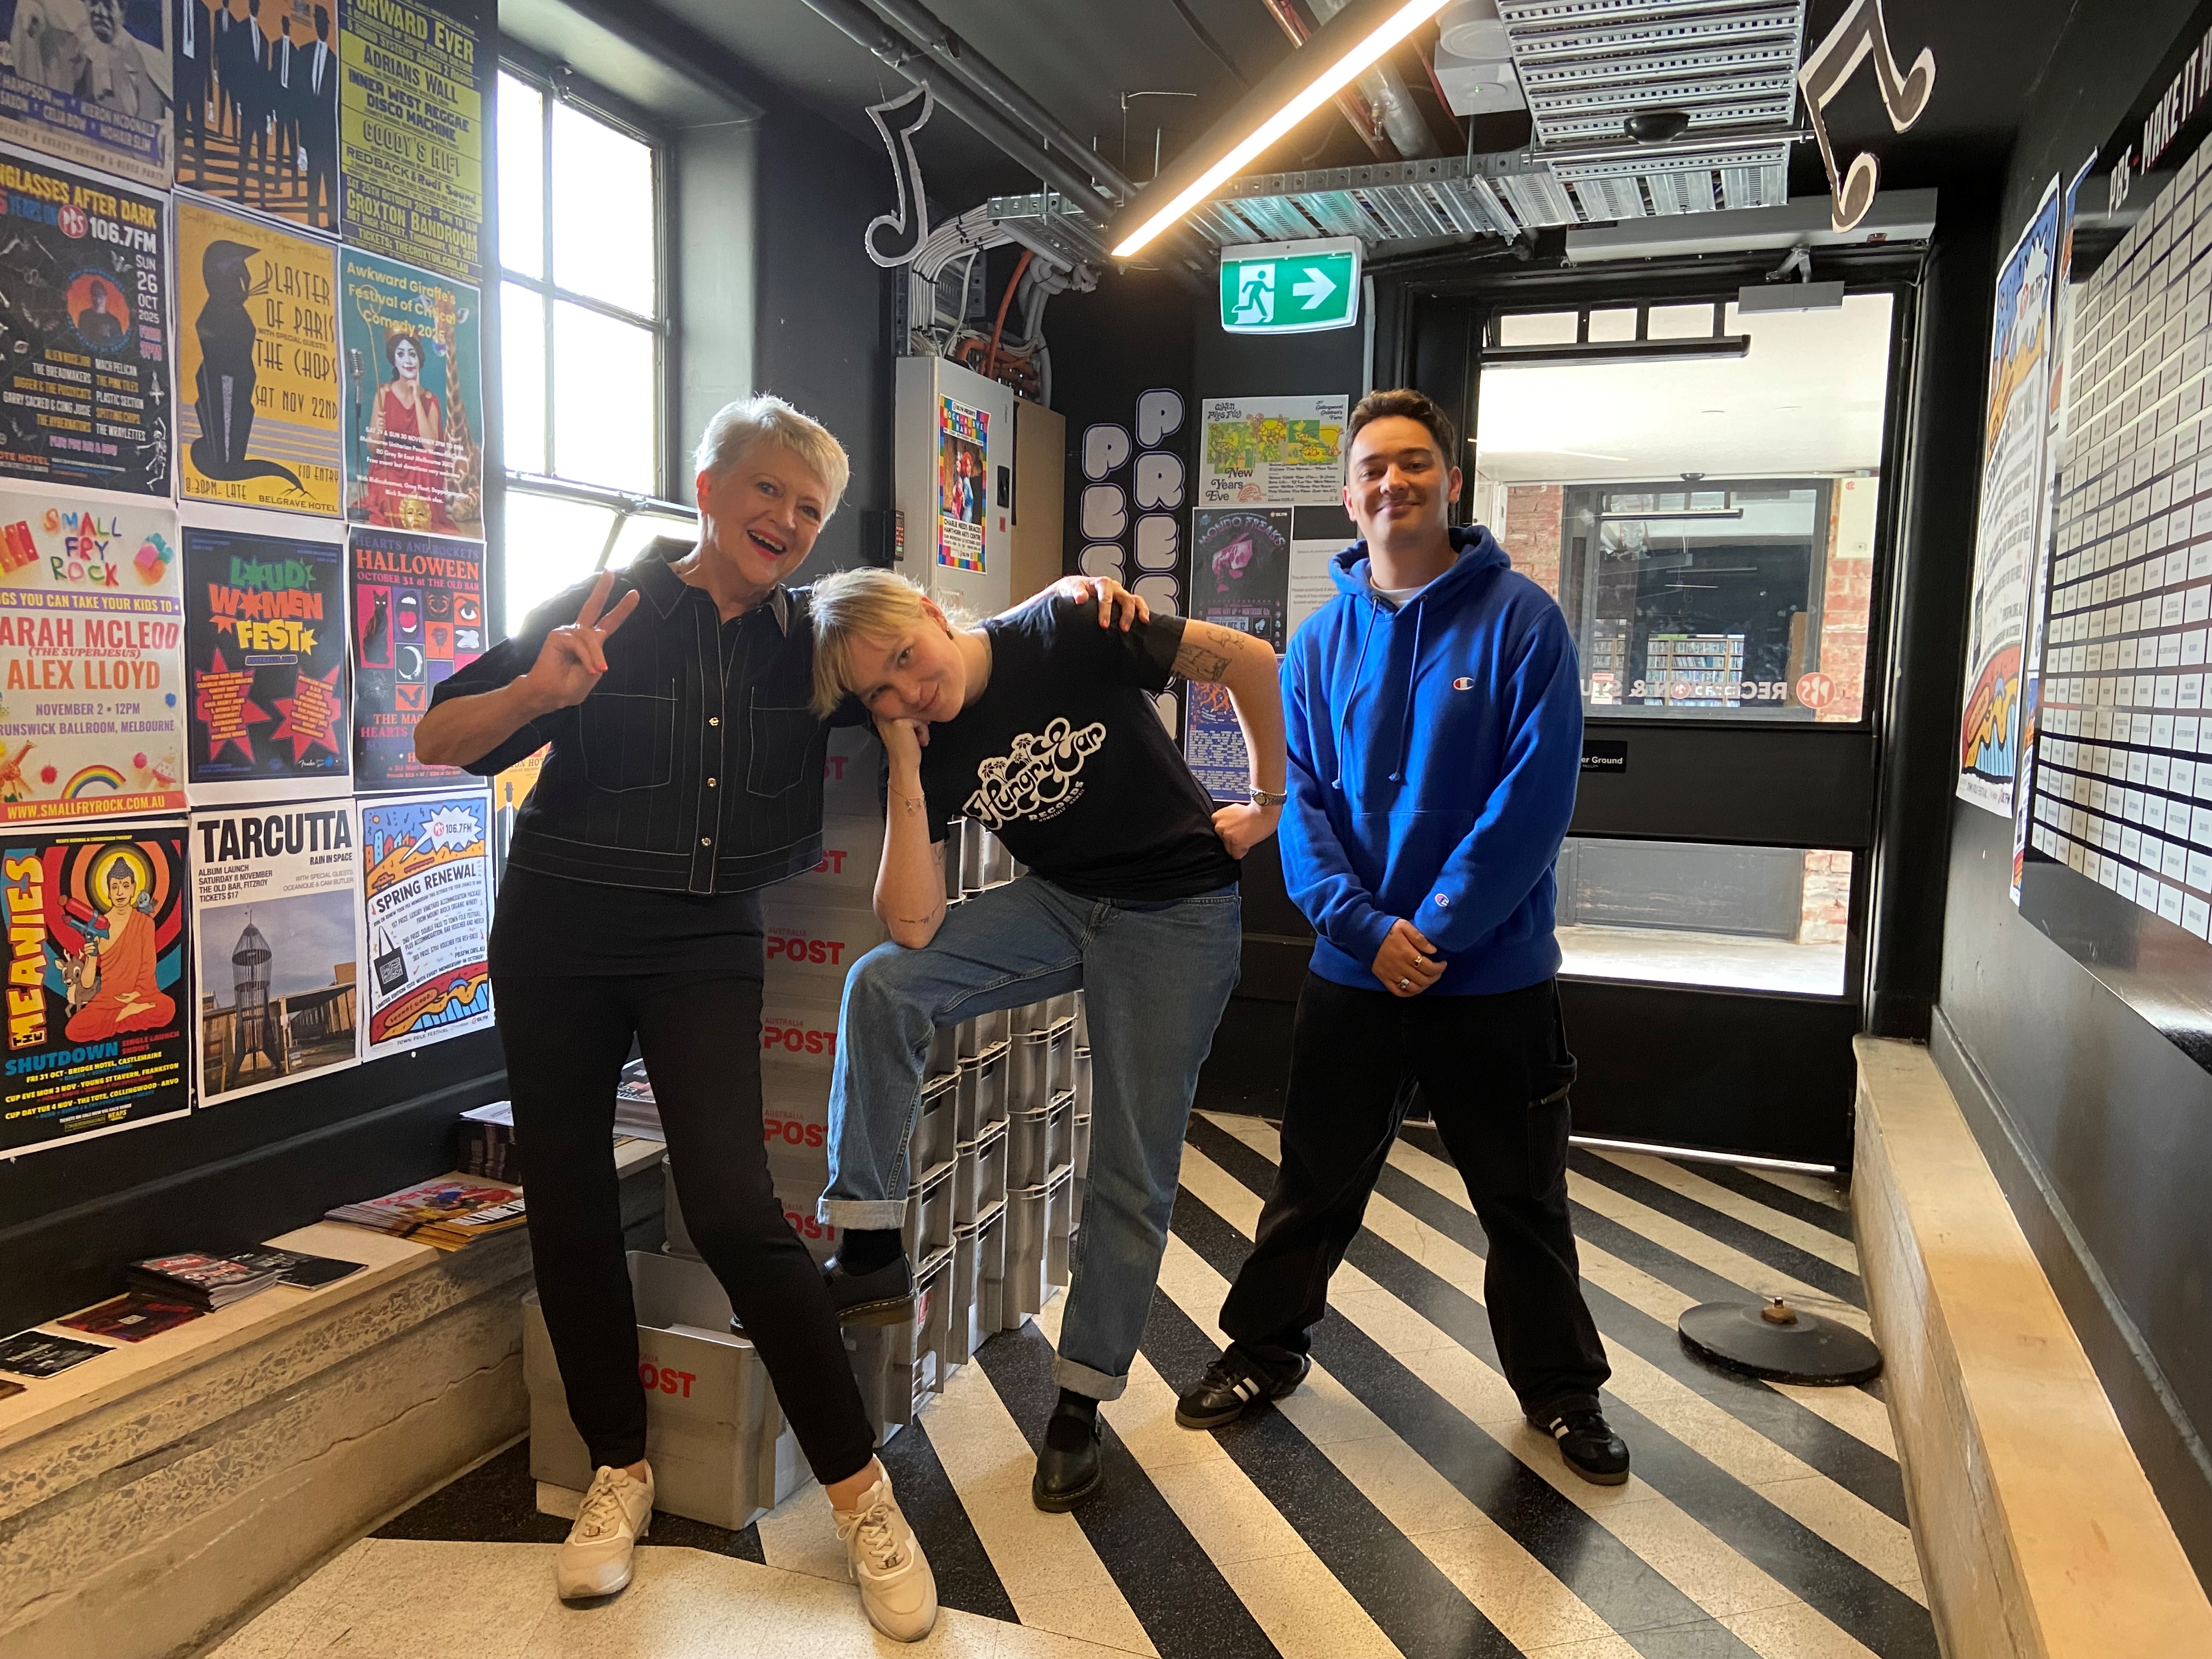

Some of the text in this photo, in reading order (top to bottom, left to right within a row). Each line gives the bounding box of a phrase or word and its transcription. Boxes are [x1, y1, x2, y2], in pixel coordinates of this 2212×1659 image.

[435, 20, 473, 64] EVER
[364, 44, 458, 104] ADRIANS WALL
[348, 68, 469, 133] INNER WEST REGGAE
[2141, 72, 2181, 176] MAKE
[2181, 46, 2199, 123] IT
[366, 92, 456, 142] DISCO MACHINE
[432, 146, 460, 177] HIFI
[73, 185, 117, 220] AFTER
[120, 199, 157, 230] DARK
[347, 188, 477, 252] CROXTON BANDROOM
[89, 216, 157, 254] 106.7FM
[136, 253, 156, 271] SUN
[395, 240, 469, 274] THECROXTON.COM.AU
[137, 272, 158, 294] 26
[265, 260, 330, 306] PLASTER
[347, 262, 456, 305] Awkward Giraffe's
[138, 293, 159, 310] OCT
[348, 284, 456, 325] Festival of Critical
[138, 310, 160, 324] 2025
[267, 298, 335, 343] OF PARIS
[363, 309, 445, 343] Comedy 2025
[255, 338, 337, 384] THE CHOPS
[255, 385, 338, 421] SAT NOV 22ND
[956, 424, 971, 436] BABY
[1211, 479, 1243, 490] Years
[1225, 467, 1253, 478] New
[258, 495, 338, 512] BELGRAVE HOTEL
[1206, 490, 1229, 501] Eve
[44, 508, 122, 538] SMALL
[1199, 516, 1286, 546] MONDO FREAKS
[65, 537, 109, 561] FRY
[356, 536, 479, 560] HEARTS AND ROCKETS
[50, 556, 119, 587] ROCK
[356, 549, 479, 580] HALLOWEEN
[358, 572, 400, 584] OCTOBER
[402, 577, 414, 585] 31
[427, 578, 445, 588] THE
[447, 580, 462, 590] OLD
[465, 582, 479, 591] BAR
[20, 593, 43, 607] YOU
[46, 594, 69, 608] CAN
[72, 595, 99, 609] TAKE
[102, 596, 131, 610] YOUR
[134, 598, 158, 612] KIDS
[160, 600, 172, 612] TO
[85, 619, 179, 650] MCLEOD
[236, 619, 303, 651] FEST
[29, 647, 141, 659] (THE SUPERJESUS)
[7, 659, 161, 690] ALEX LLOYD
[36, 703, 140, 716] NOVEMBER 2 12PM
[374, 714, 398, 724] THE
[59, 722, 118, 735] BALLROOM,
[121, 720, 175, 733] MELBOURNE
[361, 726, 408, 738] HEARTS
[1592, 756, 1623, 765] Ground
[963, 753, 1069, 830] Hungry
[1029, 781, 1084, 821] RECORDS
[8, 795, 165, 820] WWW.SMALLFRYROCK.COM.AU
[1039, 806, 1066, 822] HONOLULU
[198, 810, 352, 864] TARCUTTA
[445, 823, 472, 833] 106.7FM
[199, 865, 249, 876] ALBUM LAUNCH
[310, 853, 353, 865] RAIN IN SPACE
[199, 875, 233, 885] SATURDAY
[240, 870, 273, 881] NOVEMBER
[199, 879, 268, 894] THE OLD BAR, FITZROY
[376, 863, 476, 913] SPRING RENEWAL
[199, 893, 226, 902] TICKETS
[768, 927, 807, 937] AUSTRALIA
[6, 856, 46, 1039] MEANIES
[454, 946, 486, 958] PBSFM.ORG.AU
[766, 936, 845, 966] POST
[427, 1028, 448, 1037] FESTIVAL
[765, 1017, 804, 1028] AUSTRALIA
[764, 1026, 837, 1056] POST
[4, 1042, 119, 1076] SHUTDOWN
[26, 1051, 162, 1083] FRI 31 OCT BRIDGE HOTEL, CASTLEMAINE
[764, 1110, 803, 1120] AUSTRALIA
